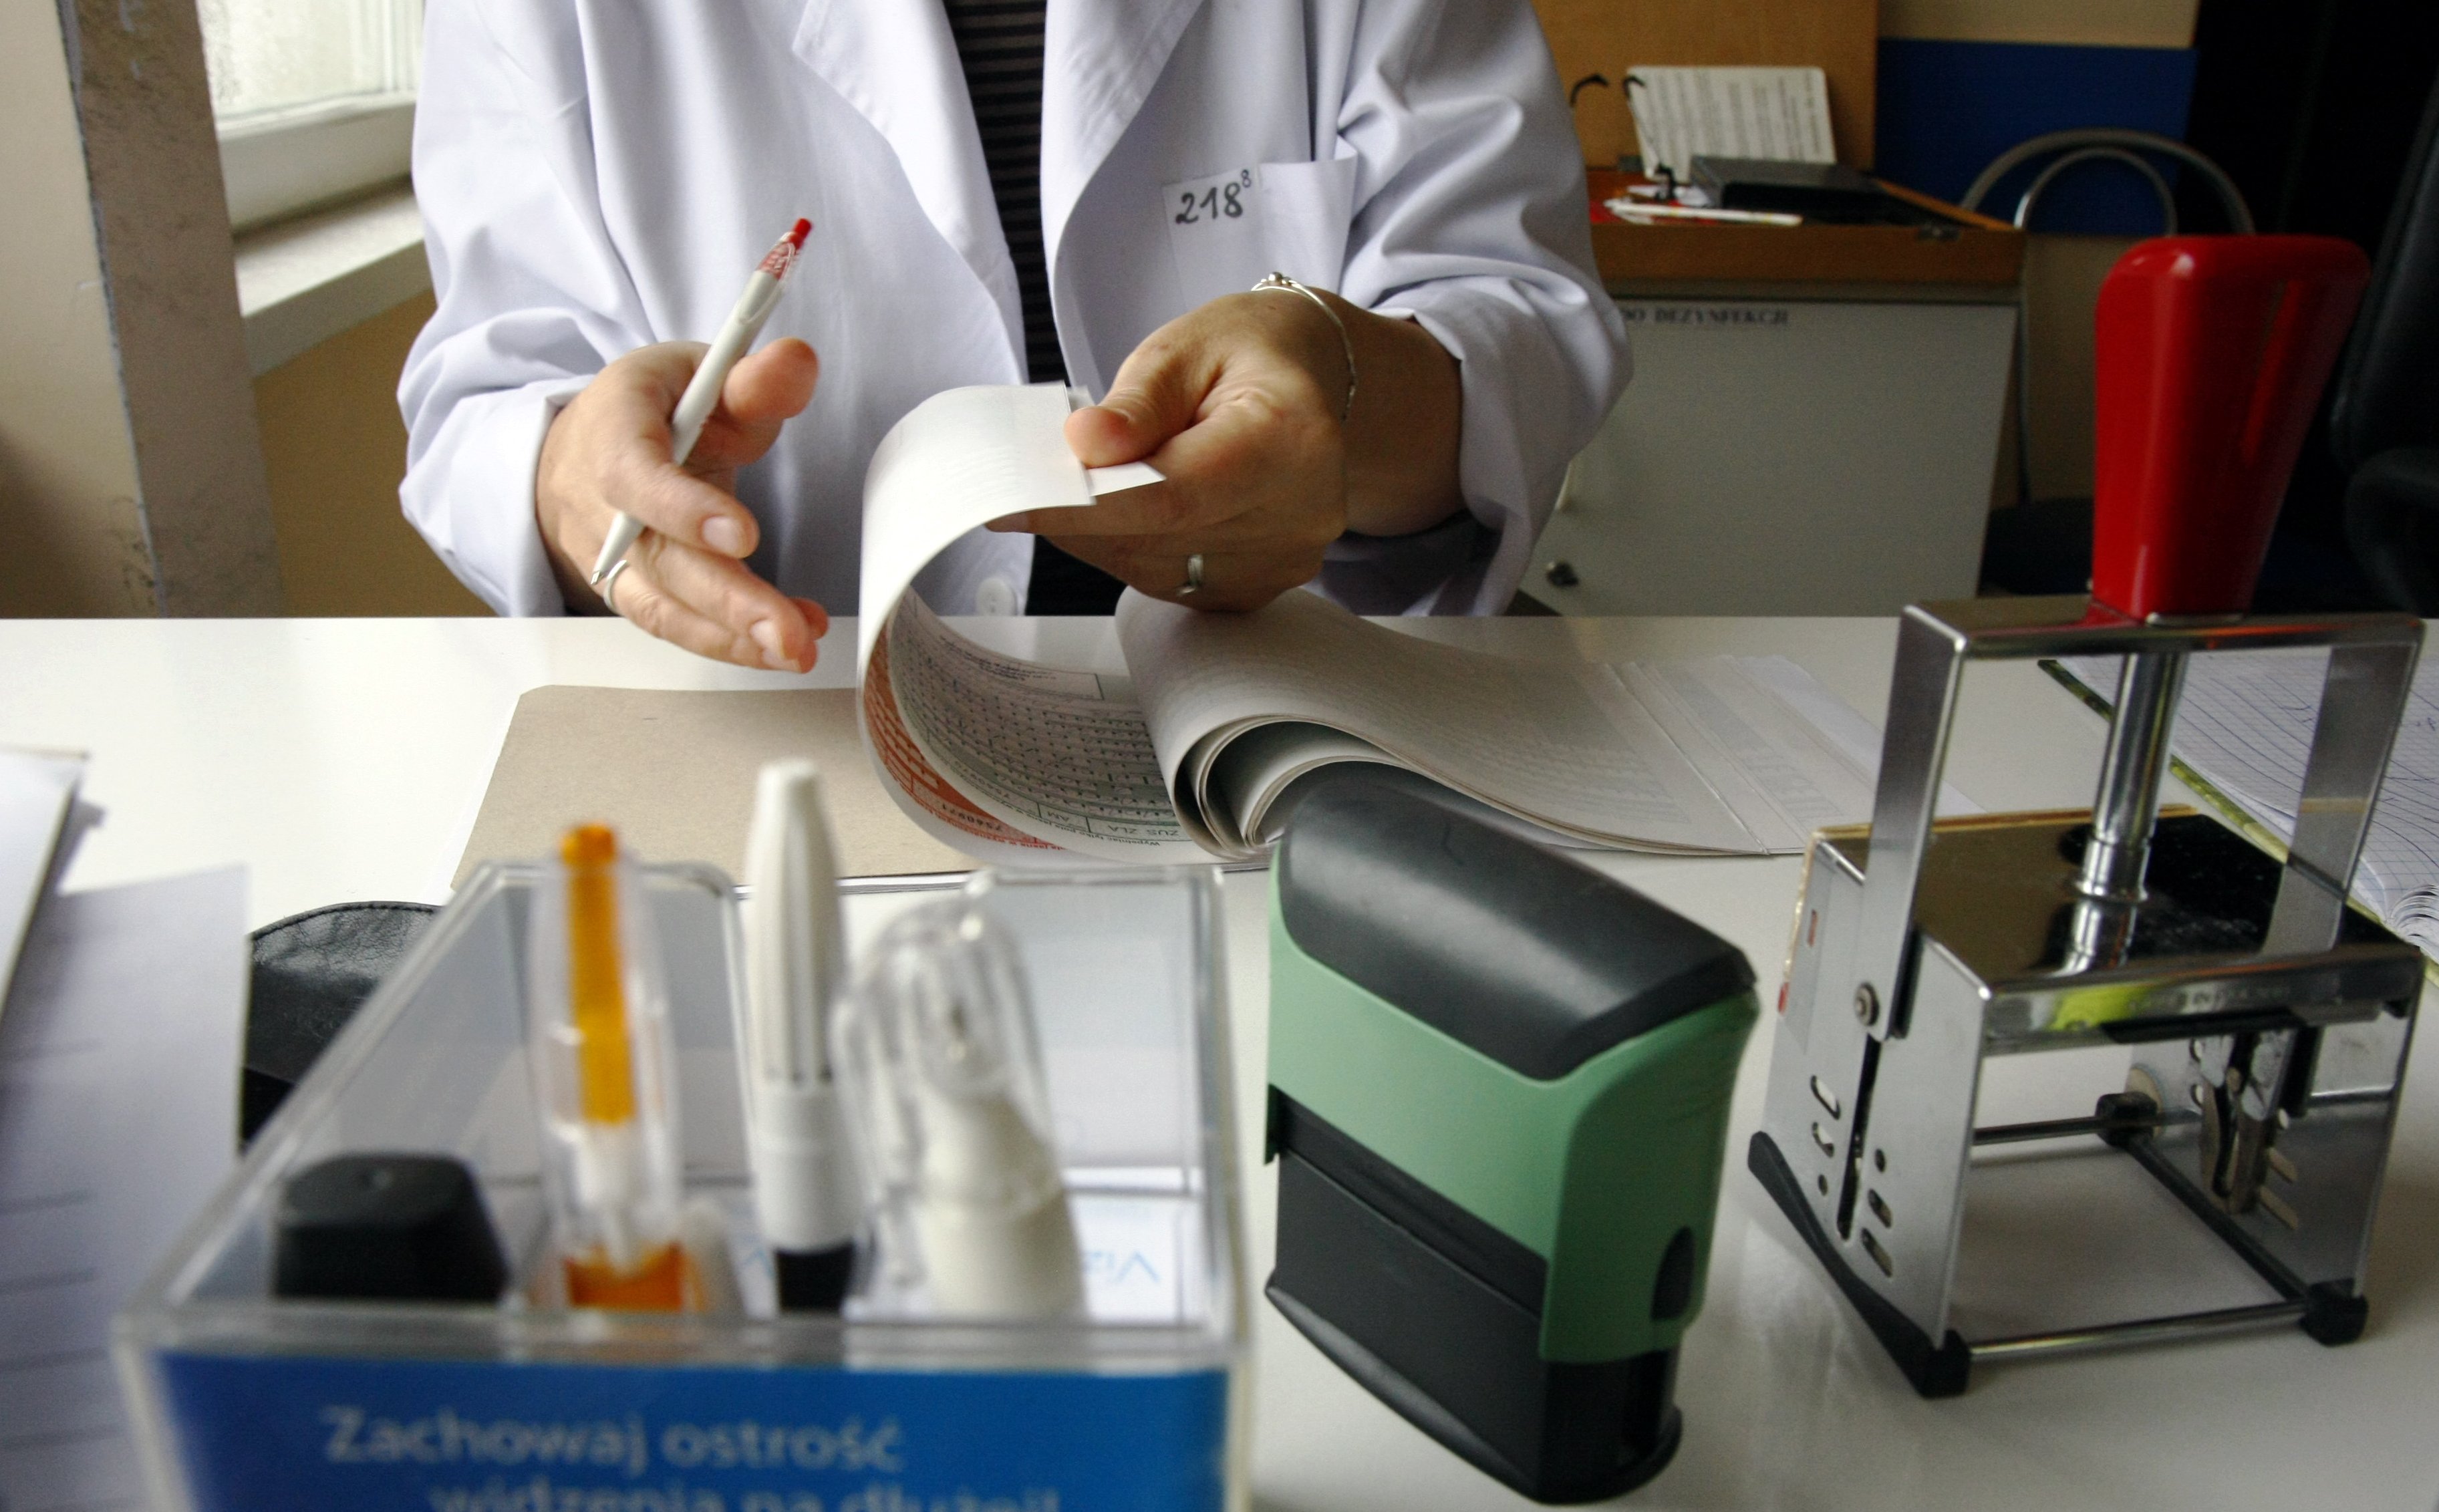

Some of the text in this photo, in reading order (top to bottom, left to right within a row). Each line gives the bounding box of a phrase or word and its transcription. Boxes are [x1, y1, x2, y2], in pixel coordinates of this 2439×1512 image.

[1175, 182, 1244, 224] 218
[1047, 810, 1069, 822] AM
[1107, 824, 1137, 835] ZLA
[322, 1404, 903, 1478] Zachowaj ostrość
